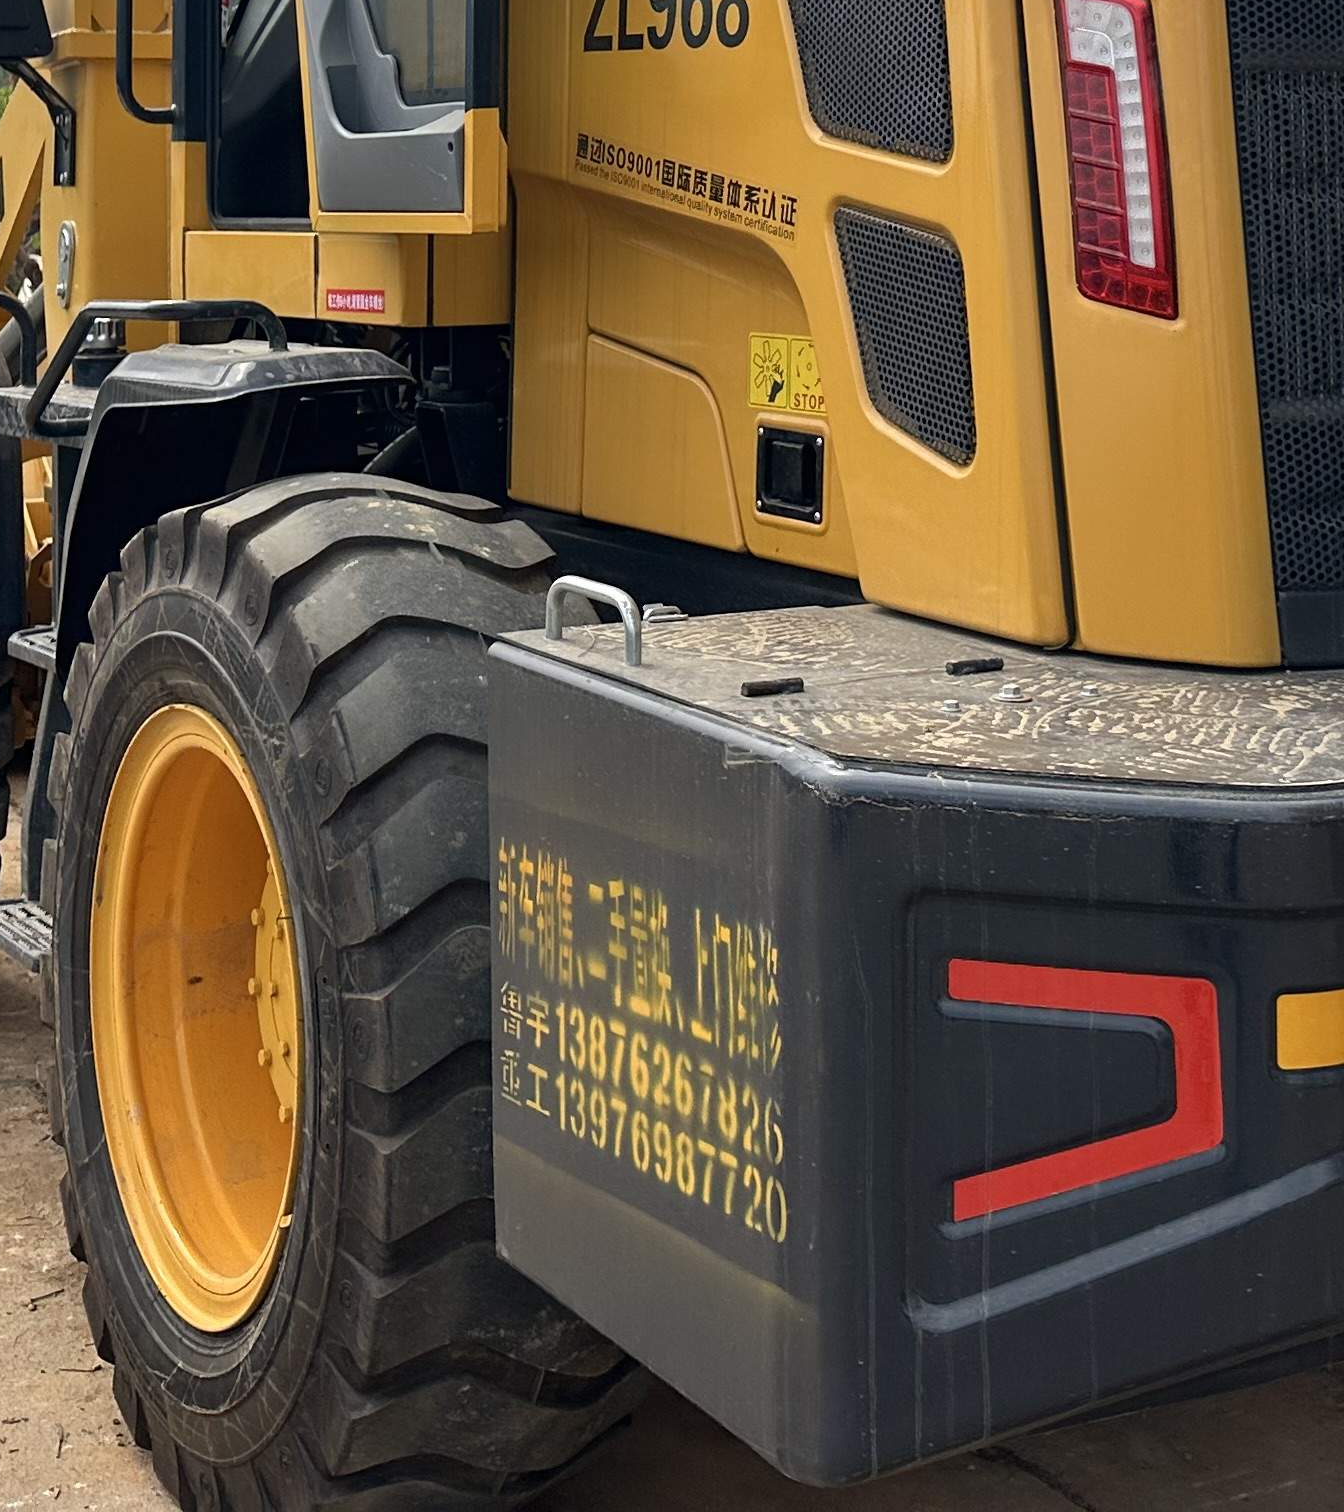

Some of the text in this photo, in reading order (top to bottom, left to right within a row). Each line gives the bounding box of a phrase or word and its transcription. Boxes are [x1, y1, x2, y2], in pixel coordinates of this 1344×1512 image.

[687, 198, 713, 217] quality
[713, 206, 743, 225] system
[744, 216, 795, 242] certification
[793, 393, 825, 410] STOP
